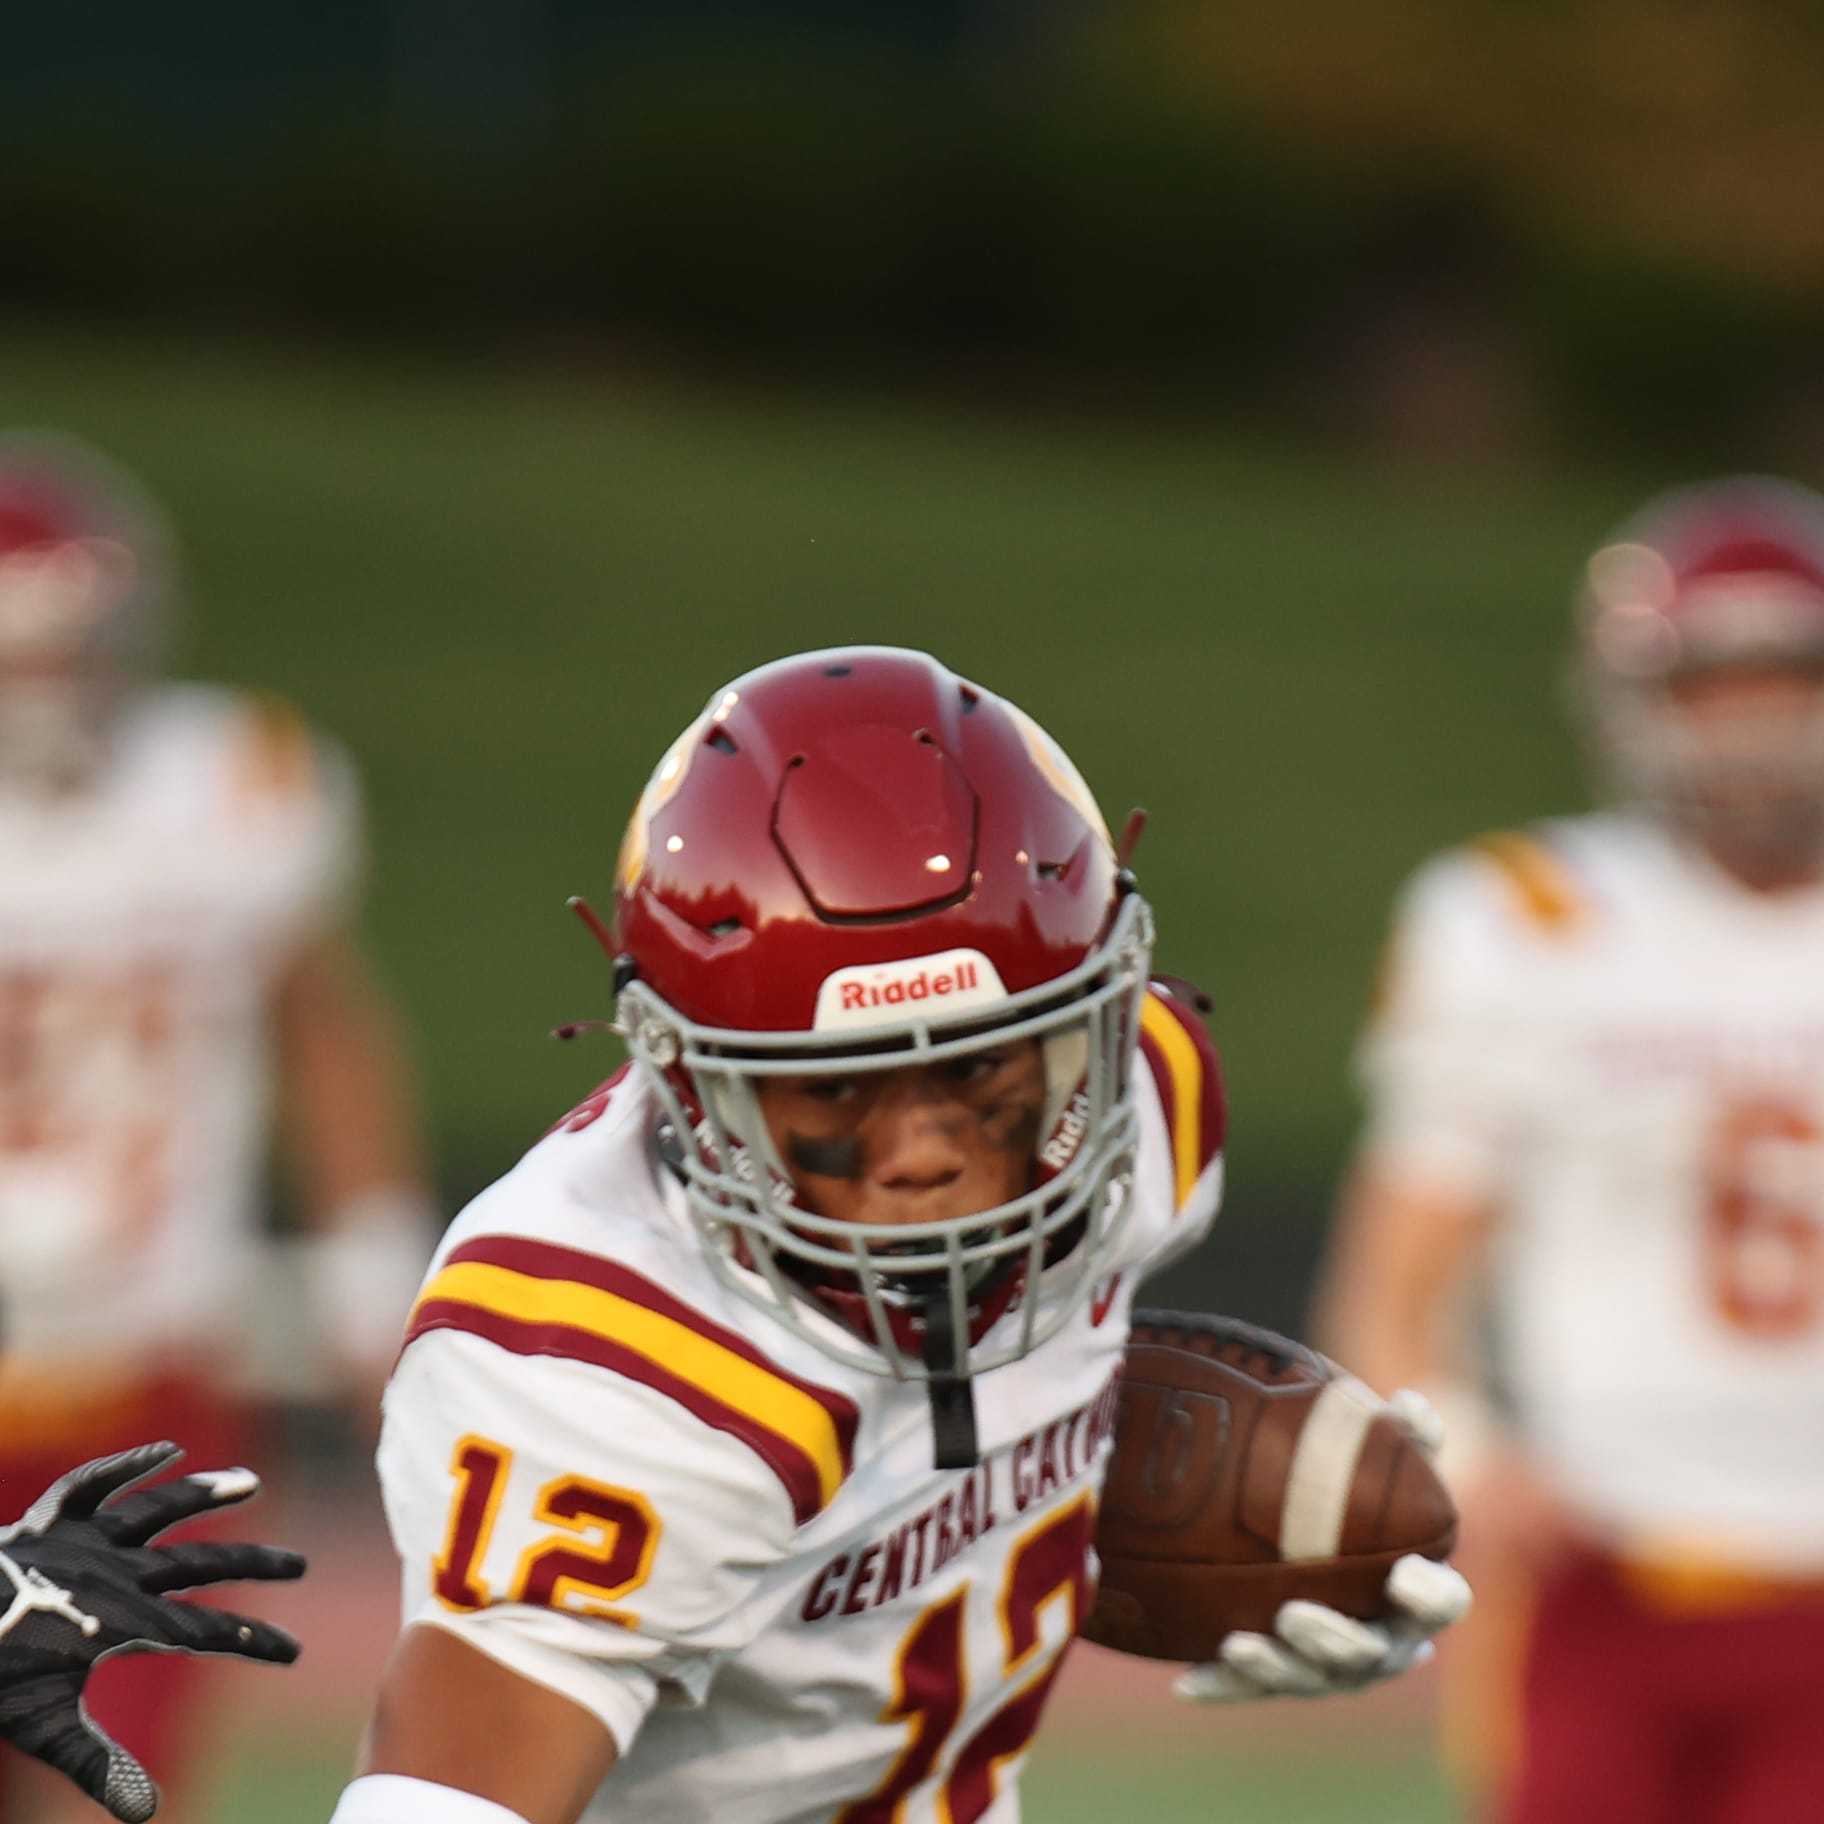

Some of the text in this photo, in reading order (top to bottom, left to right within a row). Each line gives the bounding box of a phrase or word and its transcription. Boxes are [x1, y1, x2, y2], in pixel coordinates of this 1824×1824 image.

[838, 960, 980, 1011] Riddell
[430, 1430, 665, 1633] 12
[801, 1455, 996, 1622] CENTRAL
